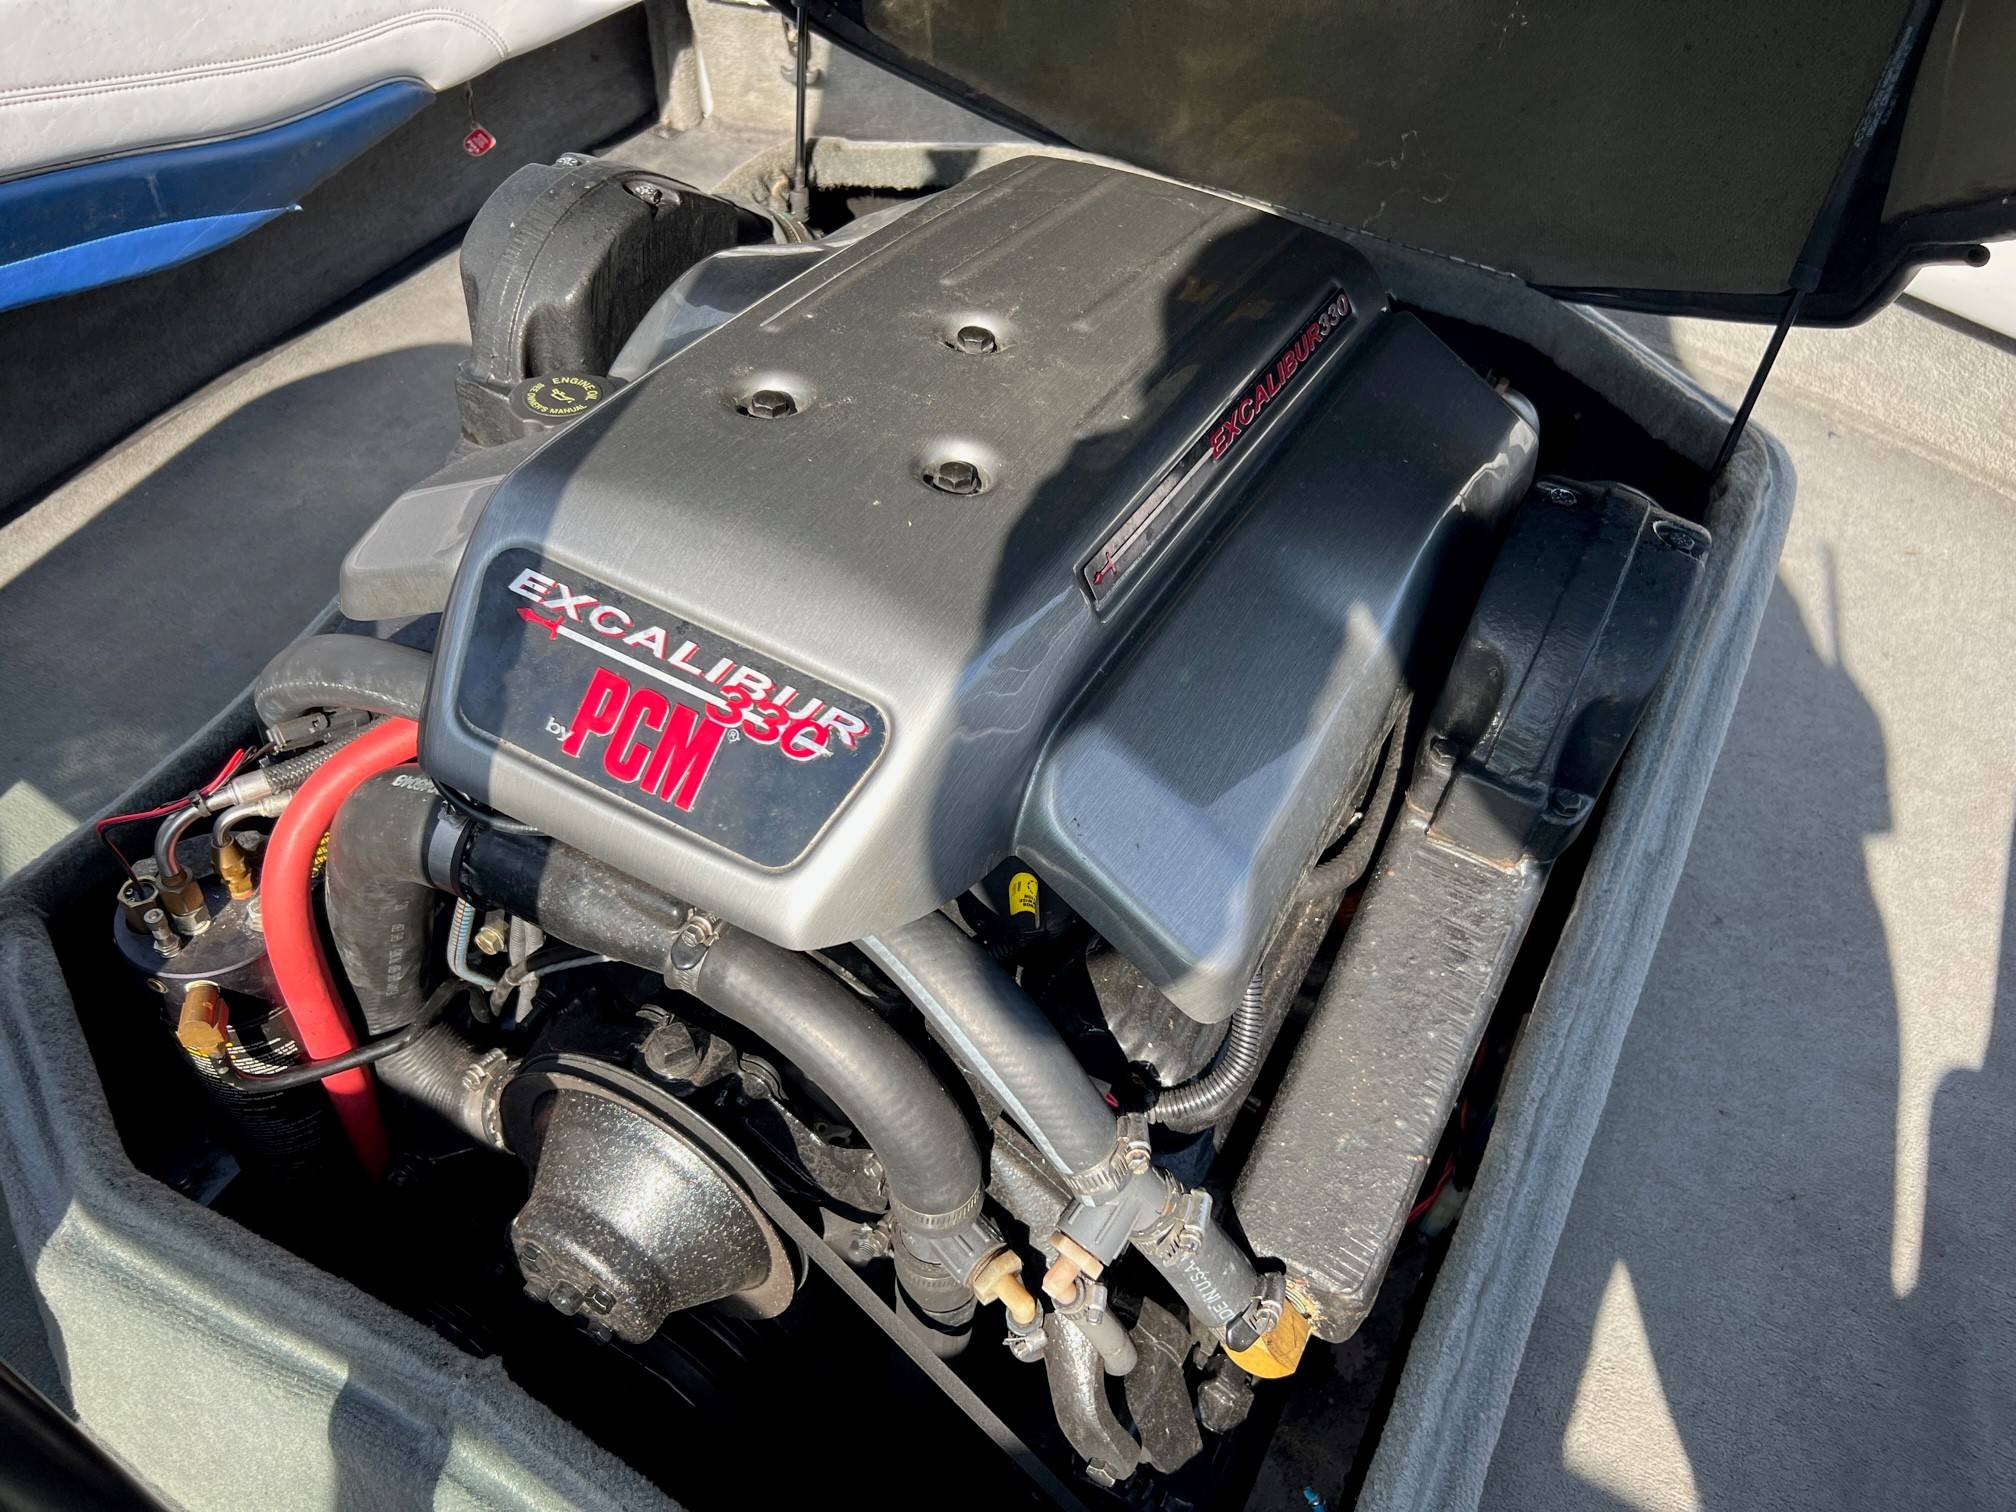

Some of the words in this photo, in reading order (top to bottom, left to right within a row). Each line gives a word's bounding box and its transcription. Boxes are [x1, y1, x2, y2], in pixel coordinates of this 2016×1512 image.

[549, 404, 588, 415] MANUAL
[552, 377, 595, 391] ENGINE
[585, 389, 599, 401] OIL
[1210, 322, 1323, 461] EXCALIBUR
[1318, 293, 1351, 338] 330
[508, 567, 870, 750] EXCALIBUR
[545, 716, 575, 743] by
[562, 666, 730, 813] PCM
[704, 684, 834, 762] 330
